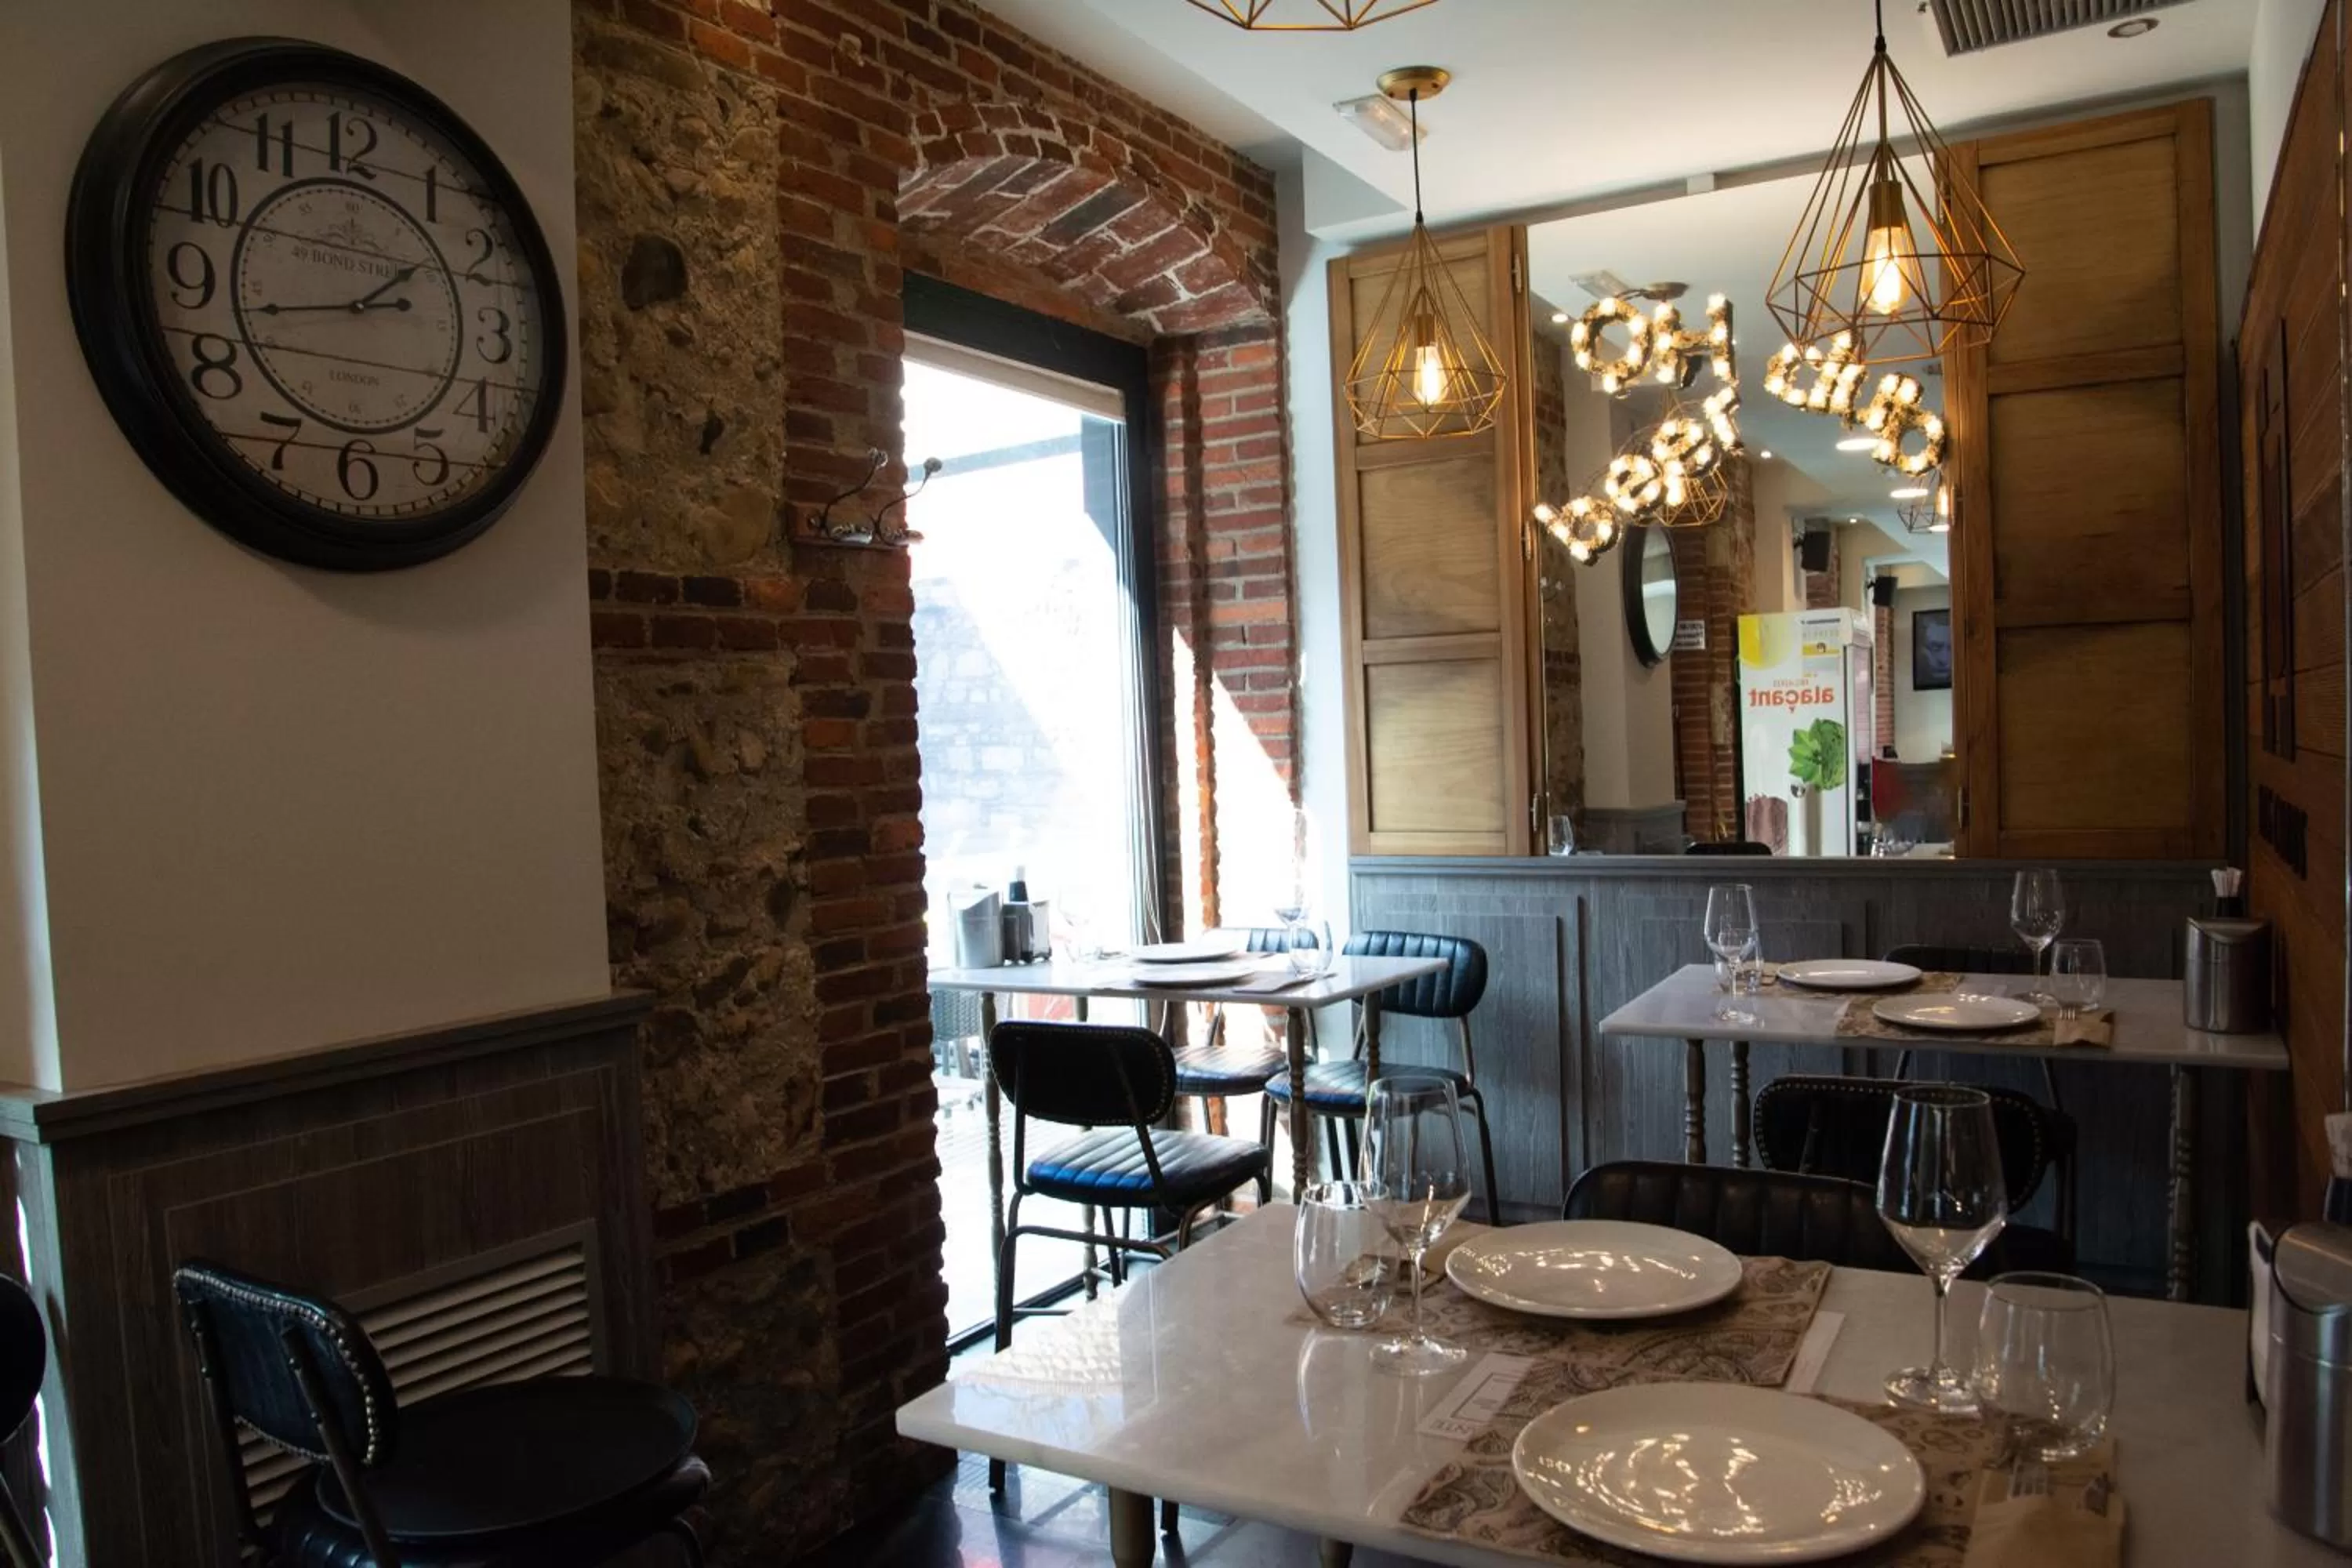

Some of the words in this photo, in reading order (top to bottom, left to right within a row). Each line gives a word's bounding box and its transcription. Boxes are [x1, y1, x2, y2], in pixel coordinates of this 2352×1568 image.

[256, 113, 294, 178] 11
[327, 111, 379, 180] 12
[190, 157, 239, 228] 10
[423, 164, 438, 223] 1
[168, 241, 216, 309] 9
[312, 249, 355, 272] BOND
[465, 228, 494, 287] 2
[476, 307, 511, 364] 3
[191, 333, 242, 399] 8
[328, 368, 380, 387] LONDON
[454, 376, 496, 433] 4
[260, 412, 301, 470] 7
[338, 439, 379, 500] 6
[413, 427, 448, 486] 5
